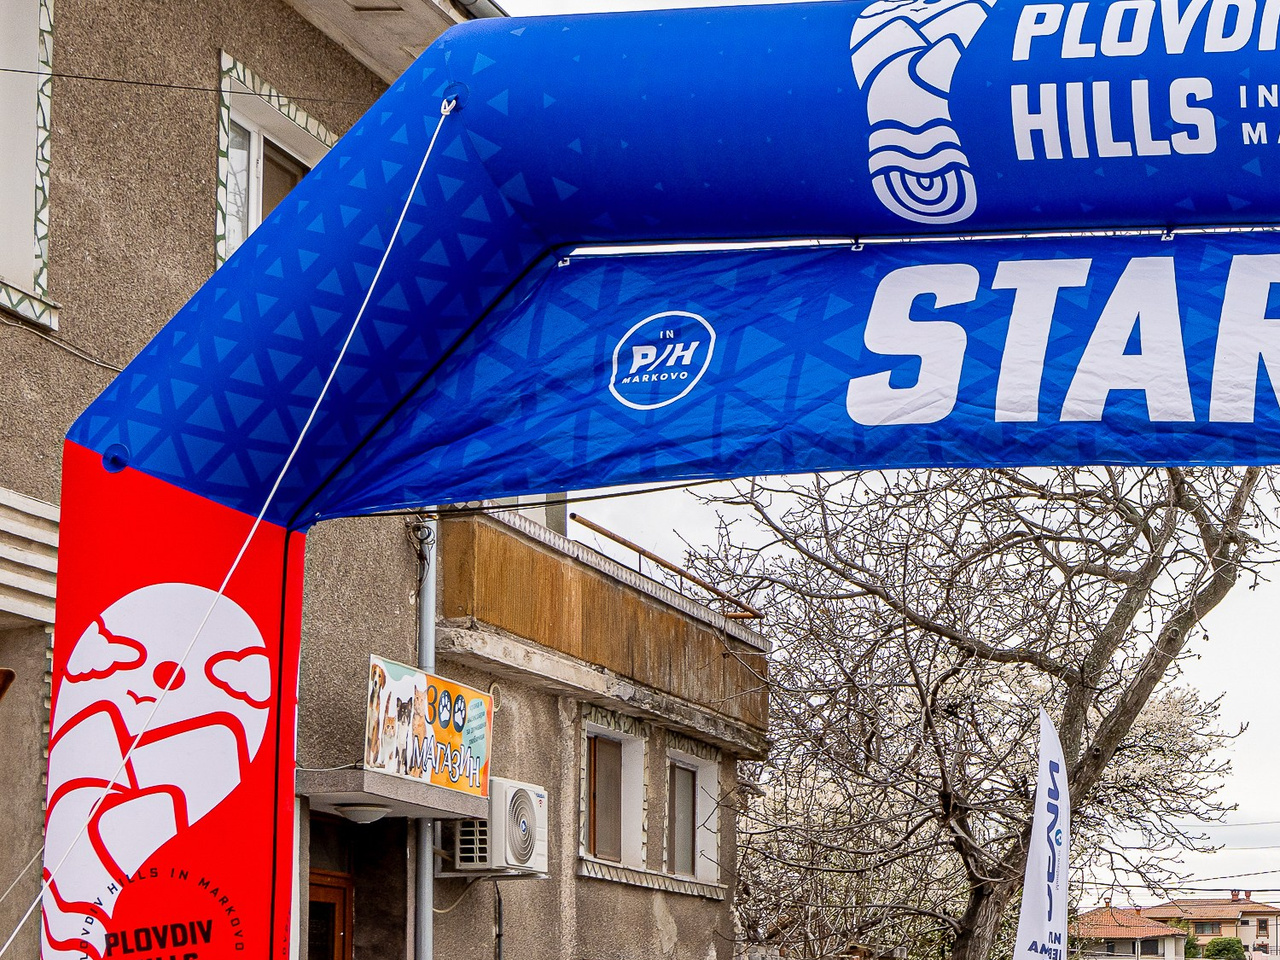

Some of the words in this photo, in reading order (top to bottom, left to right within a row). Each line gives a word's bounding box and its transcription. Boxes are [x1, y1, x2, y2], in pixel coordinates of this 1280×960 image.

[1240, 84, 1279, 108] IN
[1010, 77, 1217, 160] HILLS
[659, 329, 674, 339] IN
[629, 341, 700, 374] P/H
[621, 371, 689, 384] MARKOVO
[409, 734, 480, 788] МАГАЗИН
[107, 868, 158, 895] HILLS
[170, 868, 189, 880] IN
[198, 877, 244, 951] MARKOVO
[105, 919, 213, 957] PLOVDIV
